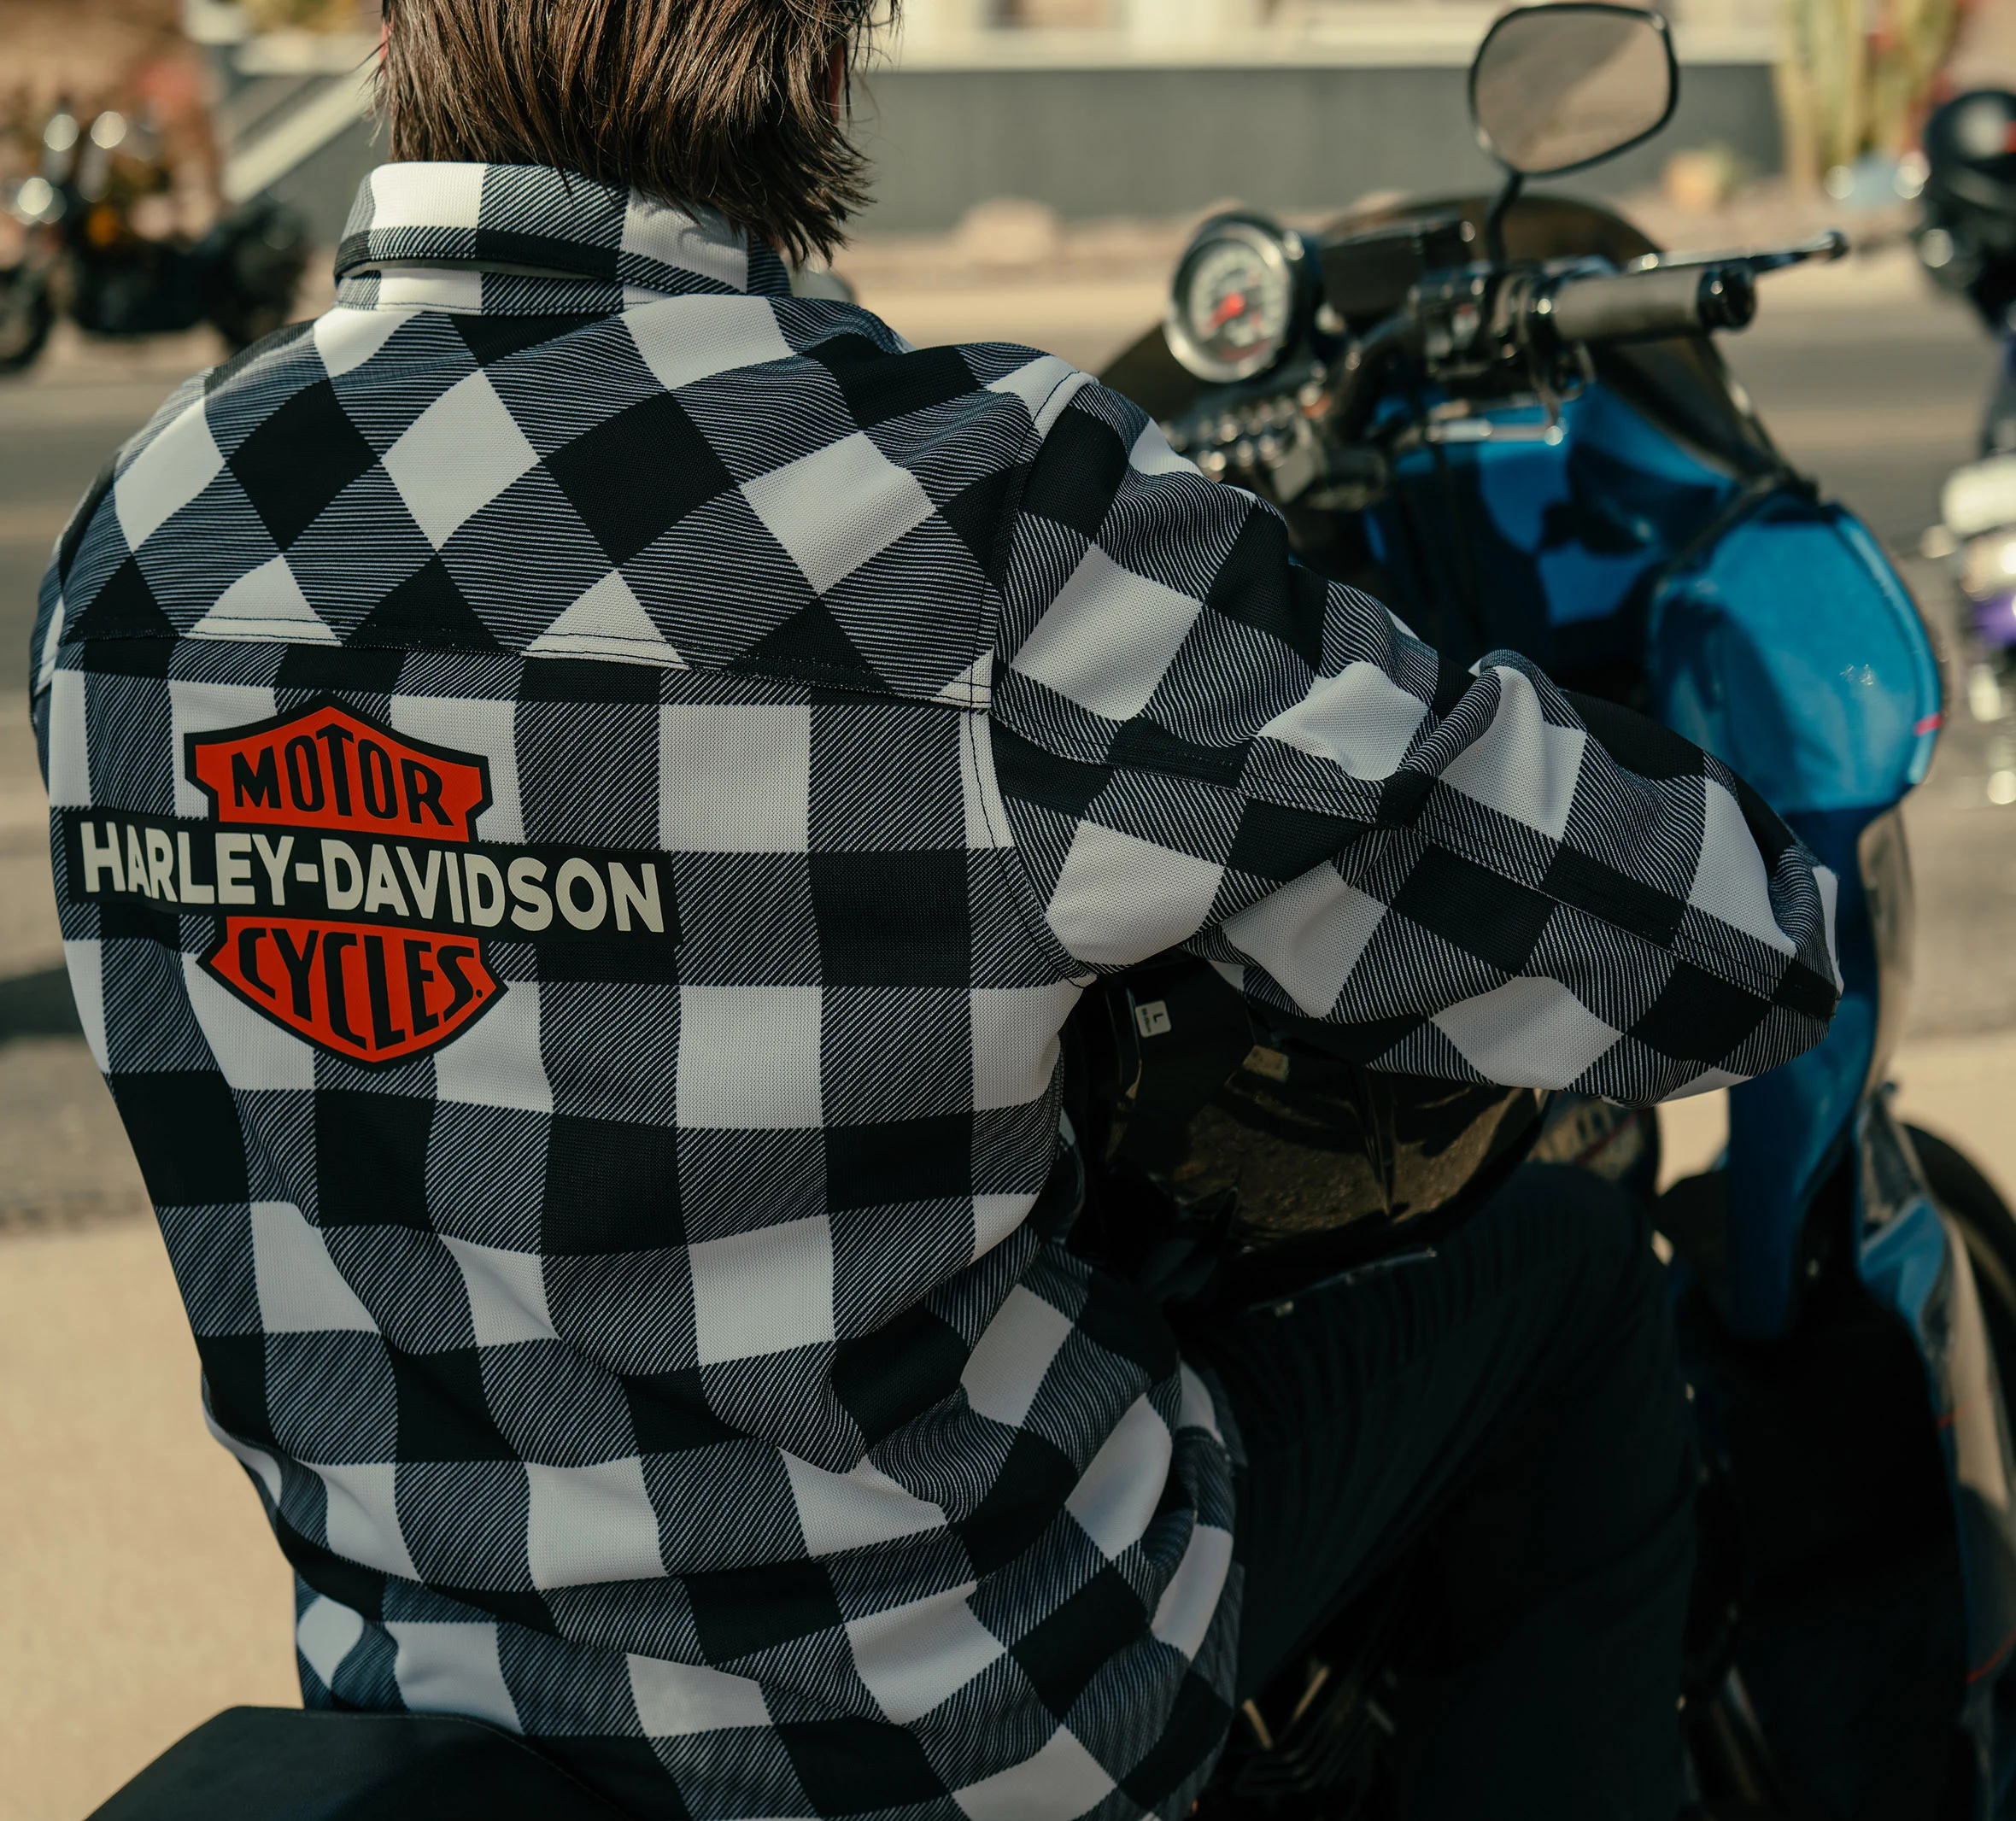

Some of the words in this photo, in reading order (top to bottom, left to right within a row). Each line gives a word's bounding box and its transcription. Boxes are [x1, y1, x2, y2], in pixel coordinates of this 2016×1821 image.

[231, 723, 454, 827] MOTOR
[80, 822, 665, 933] HARLEY-DAVIDSON
[1153, 1012, 1164, 1023] L
